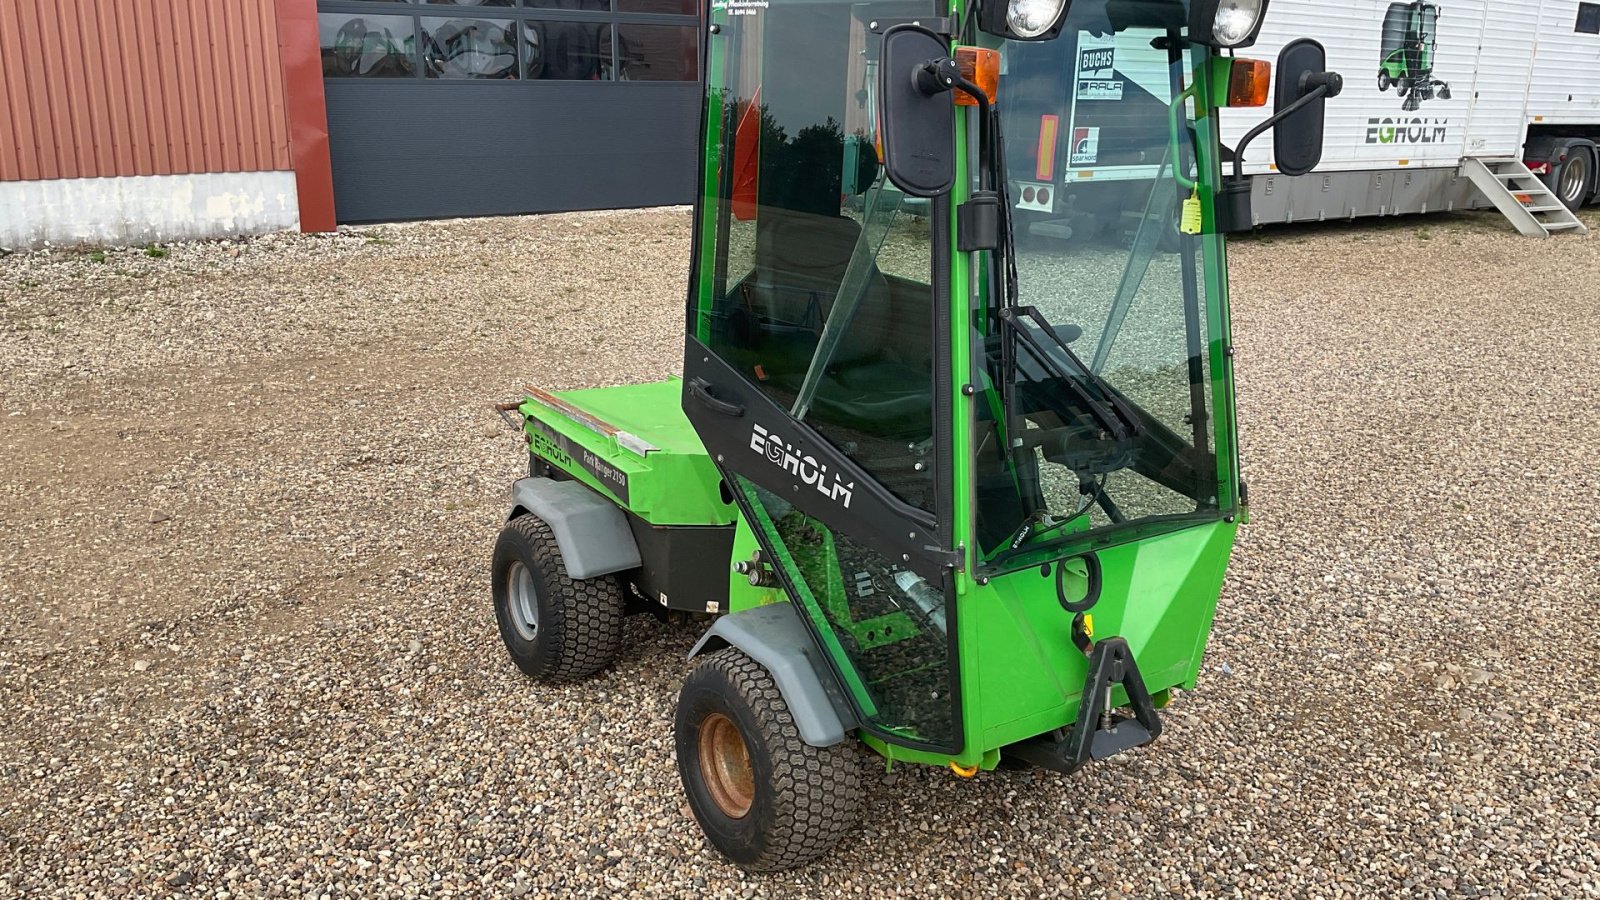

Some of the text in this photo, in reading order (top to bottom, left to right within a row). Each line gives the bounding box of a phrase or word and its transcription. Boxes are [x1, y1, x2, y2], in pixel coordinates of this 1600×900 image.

[1082, 51, 1112, 69] BUCHS
[1090, 82, 1122, 91] RALA
[1365, 117, 1447, 144] EGHOLM
[534, 433, 572, 467] EGHOLM
[583, 450, 626, 487] Park Ranger 2150
[750, 423, 854, 509] EGHOLM
